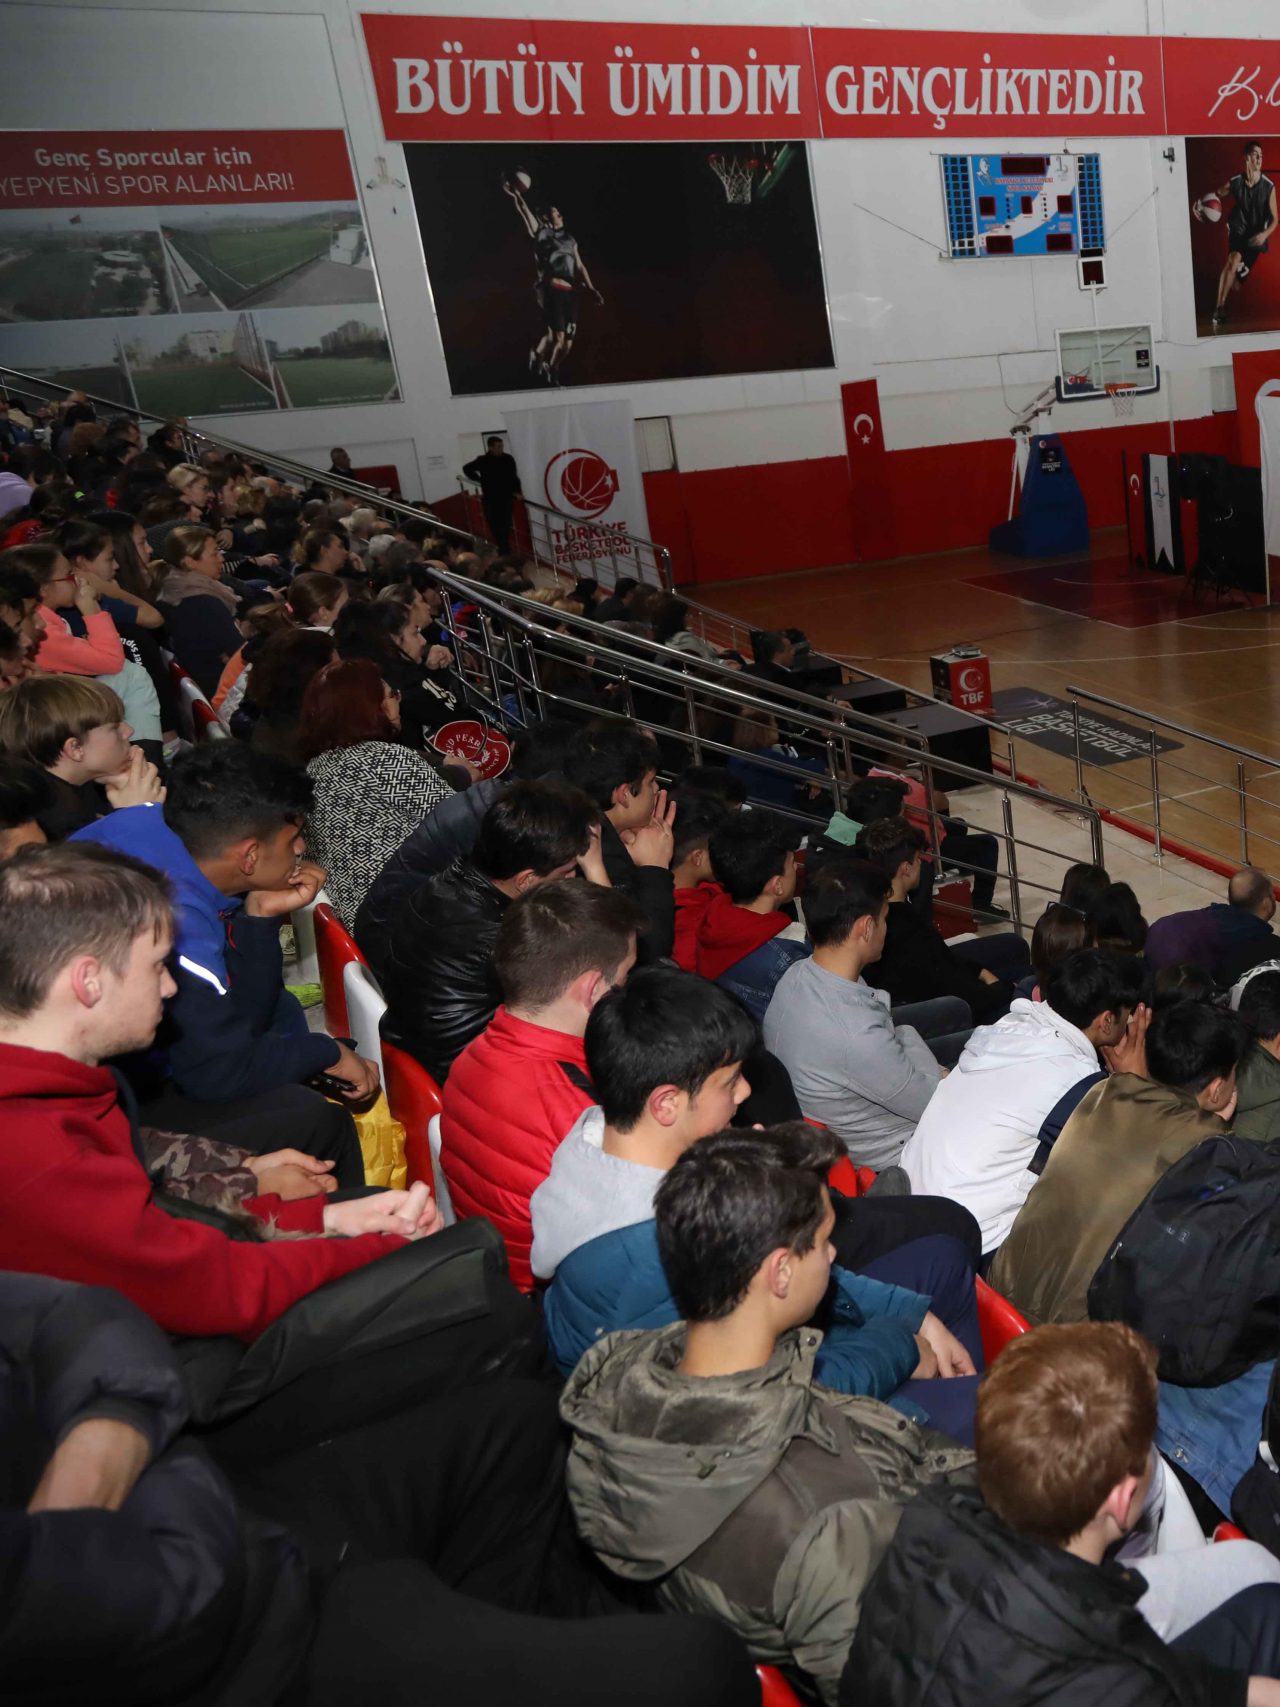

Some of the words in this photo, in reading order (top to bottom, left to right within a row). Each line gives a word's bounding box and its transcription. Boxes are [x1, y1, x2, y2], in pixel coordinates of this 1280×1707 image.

[393, 40, 585, 116] BÜTÜN
[606, 45, 801, 116] ÜMİDİM
[825, 52, 1145, 130] GENÇLİKTEDİR
[34, 148, 91, 170] Genç
[97, 148, 206, 170] Sporcular
[214, 147, 252, 169] için
[0, 172, 100, 197] YEPYENİ
[105, 174, 170, 195] SPOR
[175, 172, 296, 193] ALANLARI!
[960, 691, 985, 705] TBF
